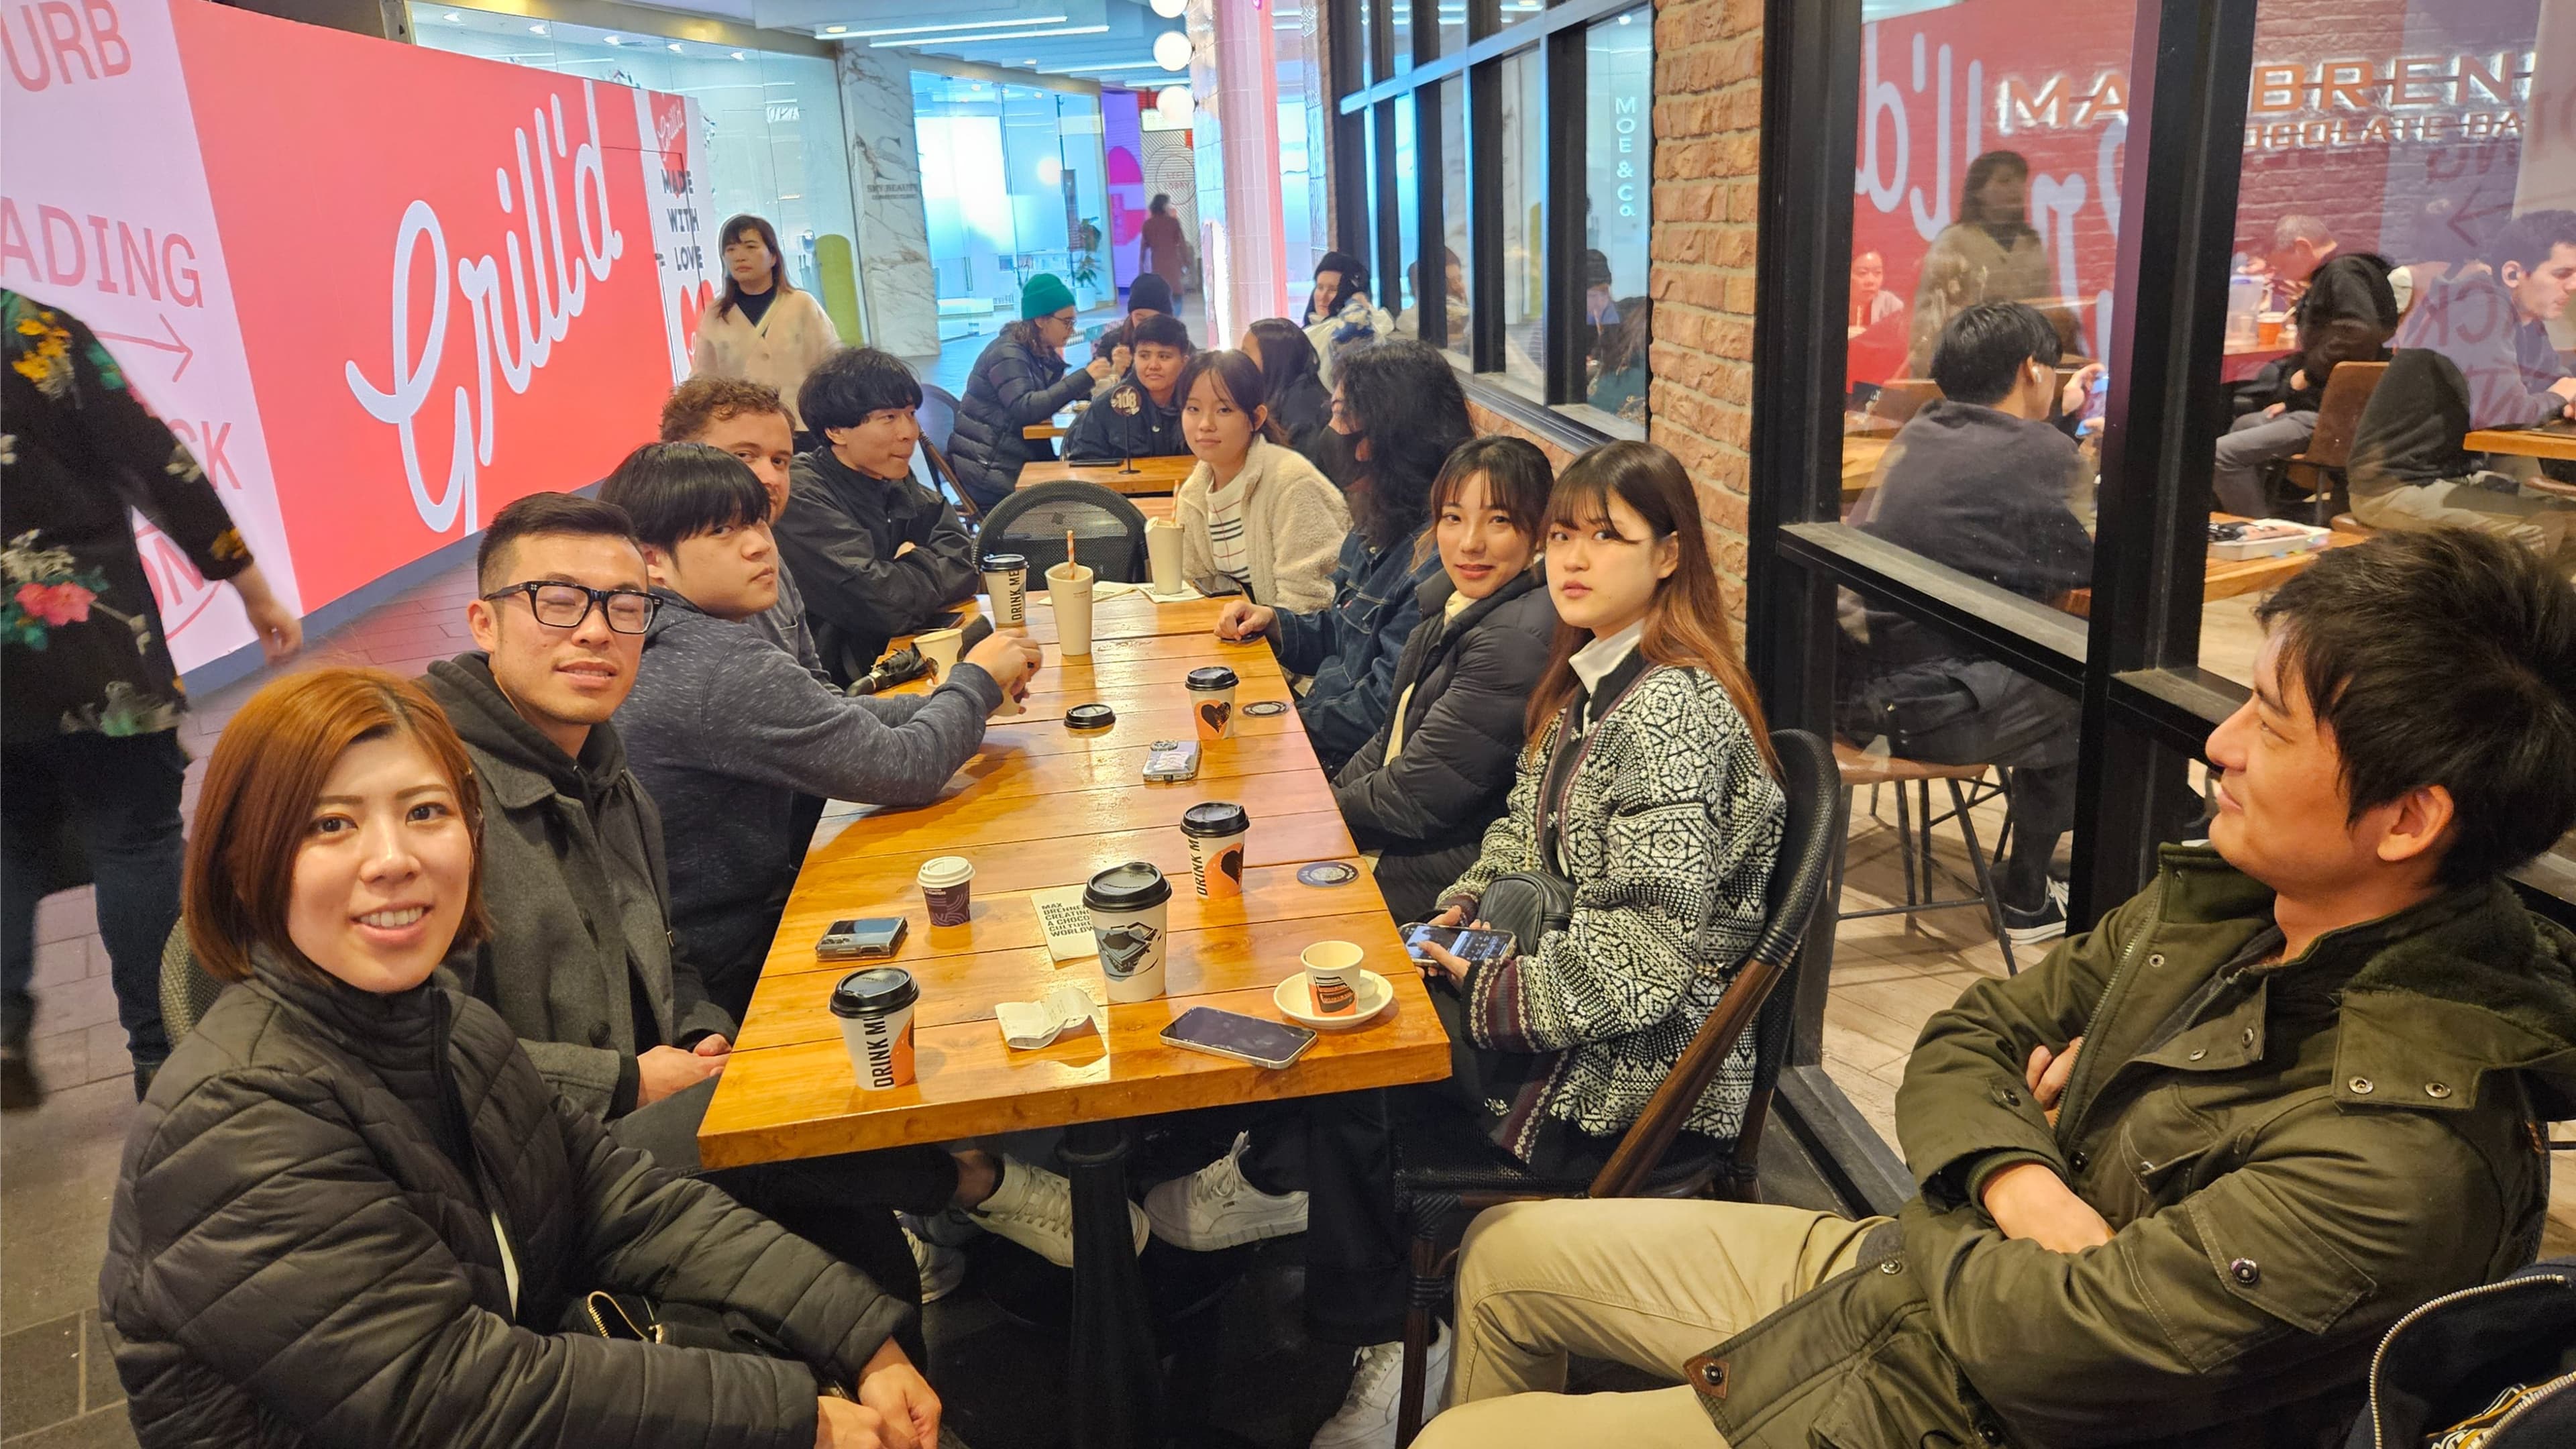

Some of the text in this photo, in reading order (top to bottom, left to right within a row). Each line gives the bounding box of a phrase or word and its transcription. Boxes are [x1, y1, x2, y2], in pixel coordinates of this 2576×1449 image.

[1615, 96, 1637, 153] MOE
[1616, 159, 1634, 178] &
[660, 169, 694, 194] MADE
[666, 208, 700, 232] WITH
[674, 246, 704, 271] LOVE
[345, 79, 623, 536] Grill'd
[1008, 570, 1022, 621] DRINK ME
[1191, 853, 1209, 896] DRINK
[1041, 902, 1063, 910] MAX
[1057, 915, 1091, 925] CHOCO
[866, 1038, 895, 1088] DRINK
